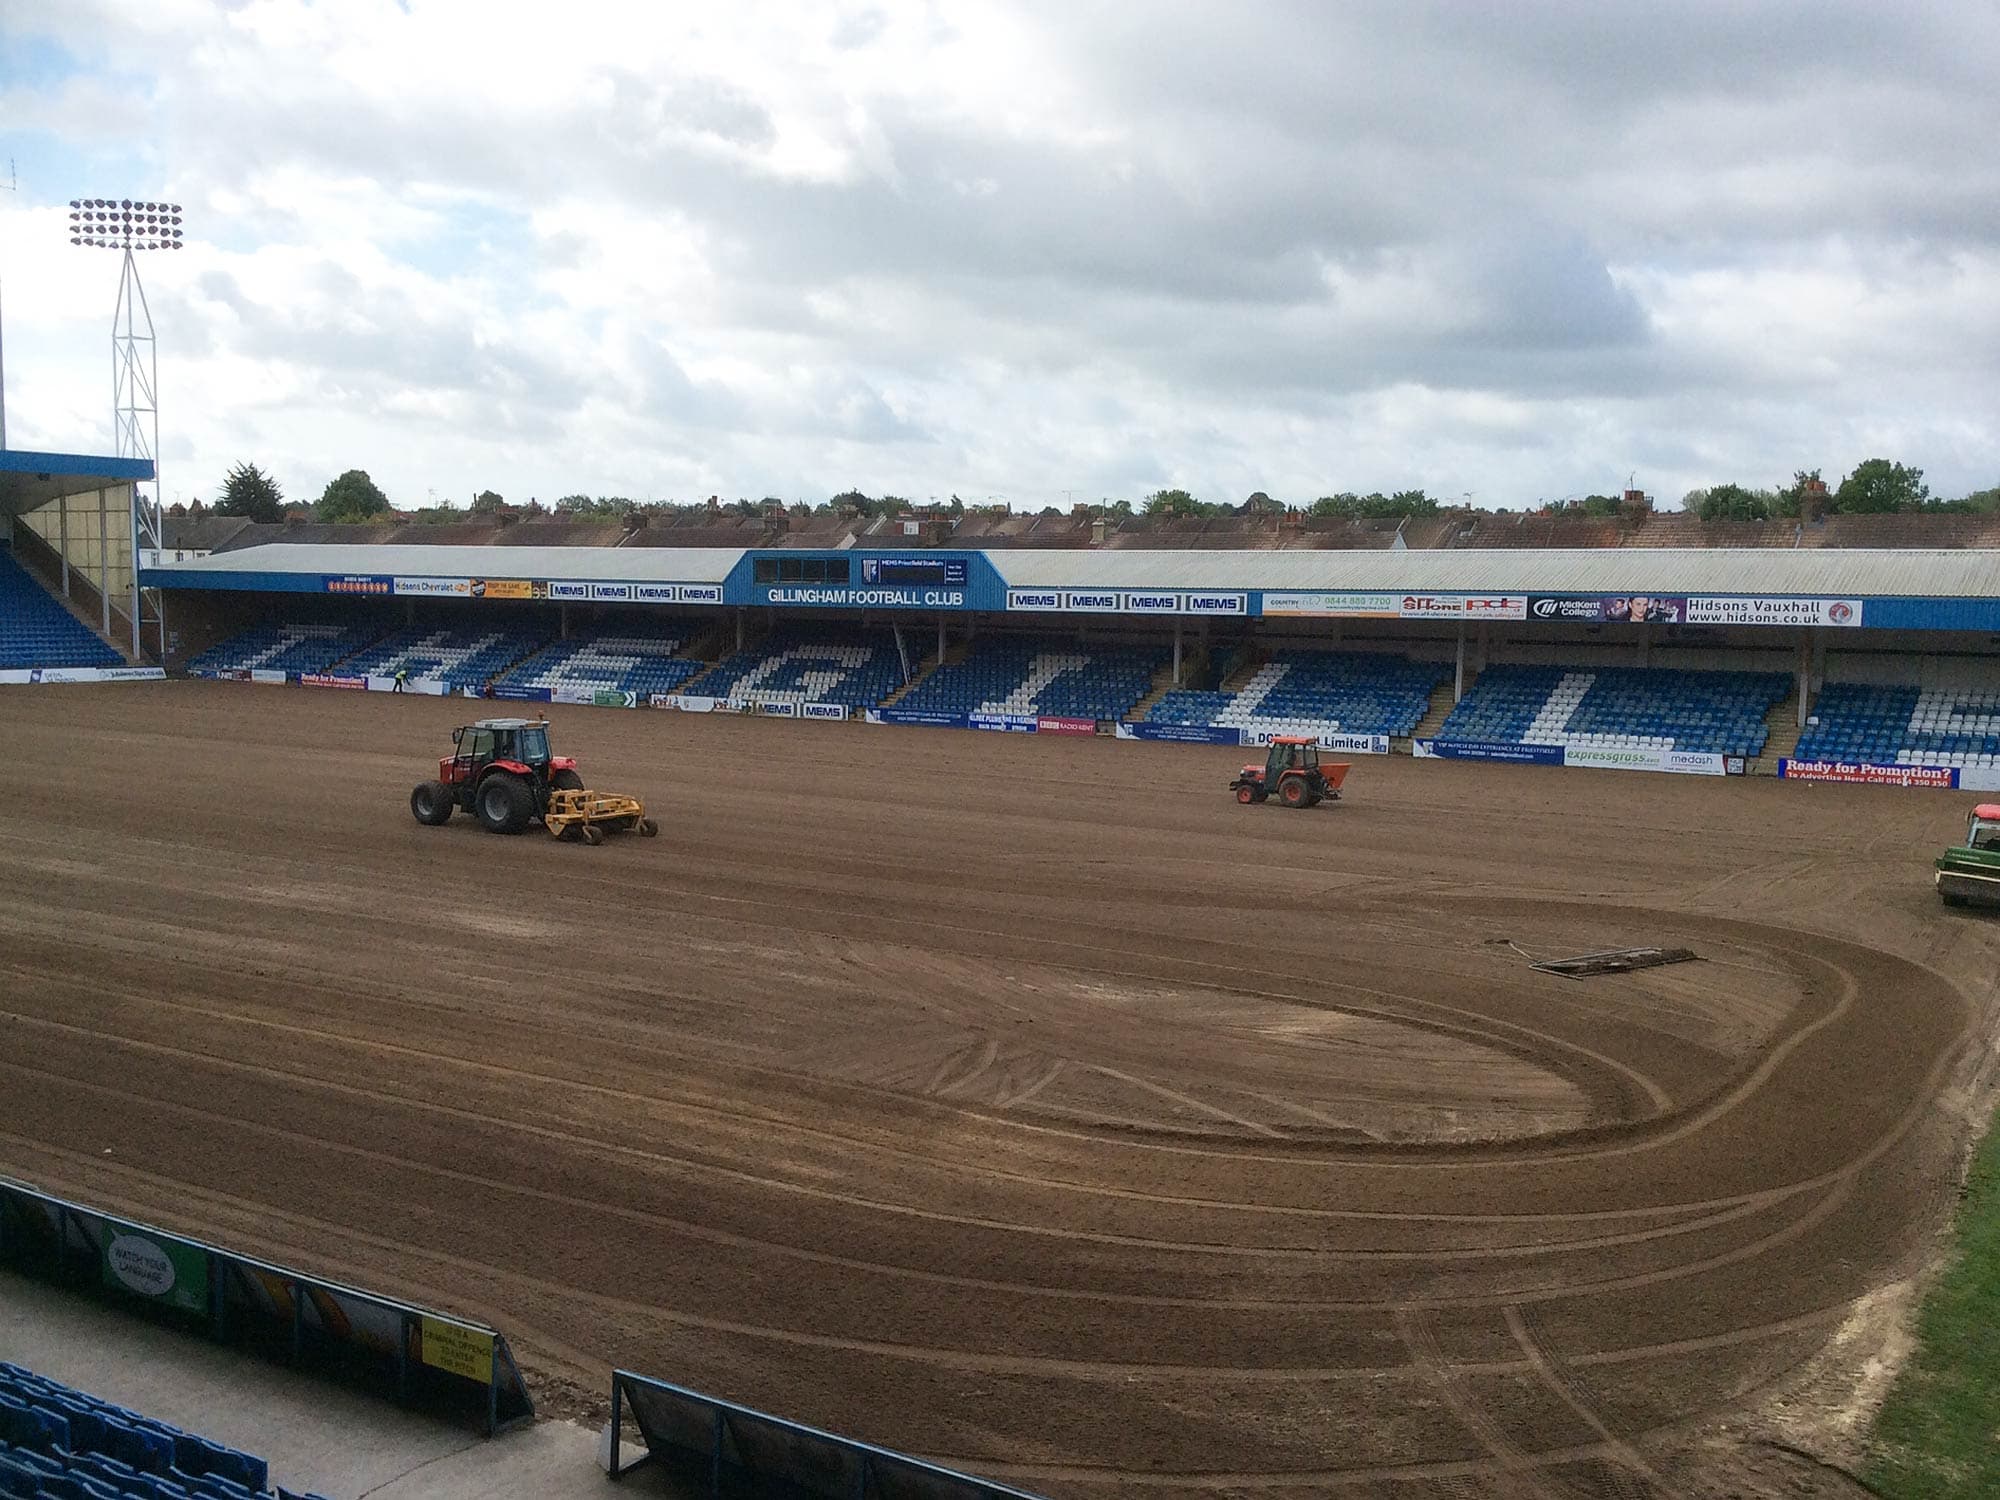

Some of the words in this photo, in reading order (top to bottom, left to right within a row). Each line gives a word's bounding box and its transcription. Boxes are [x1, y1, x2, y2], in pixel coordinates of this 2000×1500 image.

[422, 582, 454, 593] Chevrolet
[554, 586, 584, 596] MEMS
[596, 587, 627, 597] MEMS
[639, 587, 671, 598] MEMS
[684, 588, 716, 599] MEMS
[768, 588, 846, 604] GILLINGHAM
[849, 590, 920, 605] FOOTBALL
[924, 591, 963, 606] CLUB
[1015, 595, 1055, 606] MEMS
[1072, 595, 1113, 607] MEMS
[1132, 597, 1174, 608] MEMS
[1192, 597, 1237, 609] MEMS
[1559, 600, 1600, 610] MidKent
[1688, 599, 1749, 611] Hidsons
[1753, 600, 1821, 613] Vauxhall
[1561, 608, 1599, 618] College
[1688, 612, 1820, 624] www.hidsons.co.uk
[758, 702, 792, 714] MEMS
[806, 705, 841, 717] MEMS
[1324, 736, 1369, 750] Limited
[1786, 759, 1834, 775] Ready
[1835, 762, 1857, 774] for
[1860, 763, 1952, 780] Promotion?
[1800, 773, 1843, 781] Advertise
[1867, 775, 1885, 784] Call
